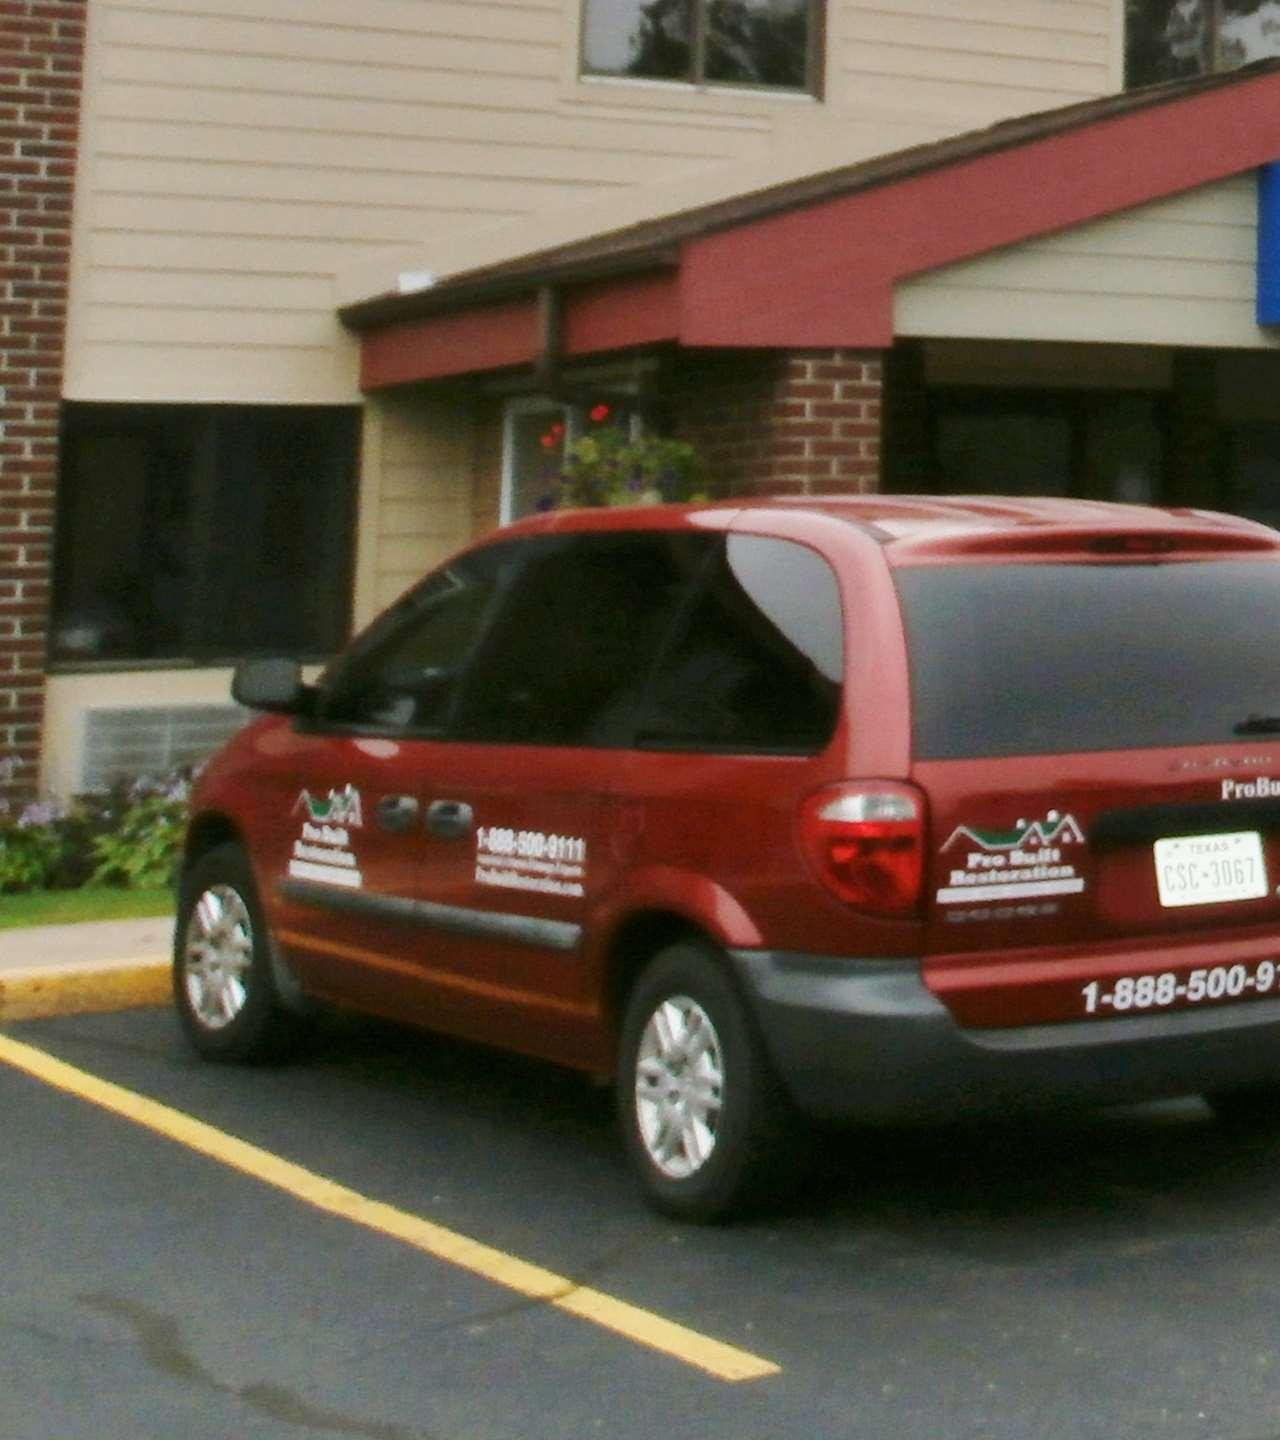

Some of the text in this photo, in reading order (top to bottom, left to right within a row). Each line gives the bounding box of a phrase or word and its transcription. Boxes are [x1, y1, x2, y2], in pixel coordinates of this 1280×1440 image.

[966, 847, 1062, 869] Pro Built
[1189, 841, 1230, 854] TEXAS
[949, 864, 1076, 886] Restoration
